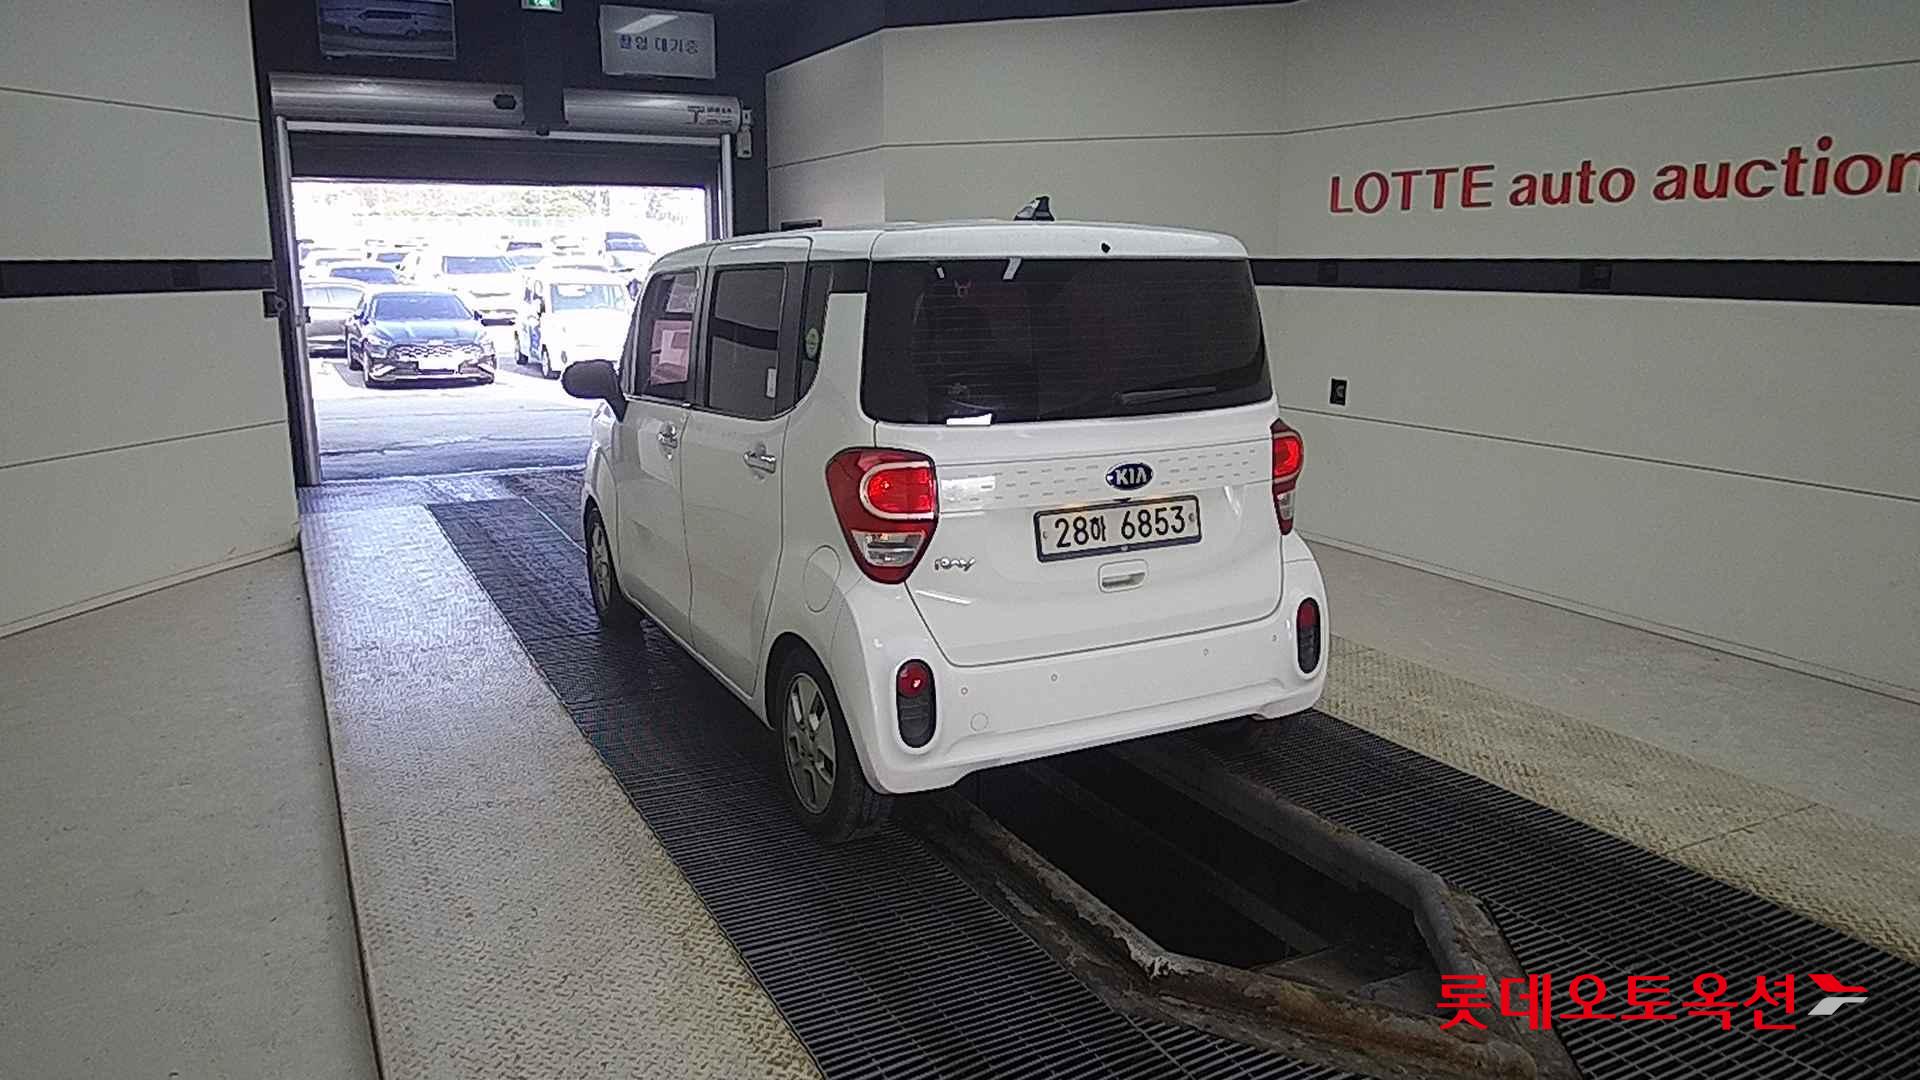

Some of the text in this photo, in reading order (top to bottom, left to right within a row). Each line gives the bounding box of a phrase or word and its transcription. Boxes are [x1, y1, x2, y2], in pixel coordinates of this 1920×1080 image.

[655, 36, 699, 55] 대기중
[1329, 136, 1920, 214] LOTTE auto auction
[1114, 465, 1149, 486] KIA
[1054, 505, 1186, 548] 28하 6853
